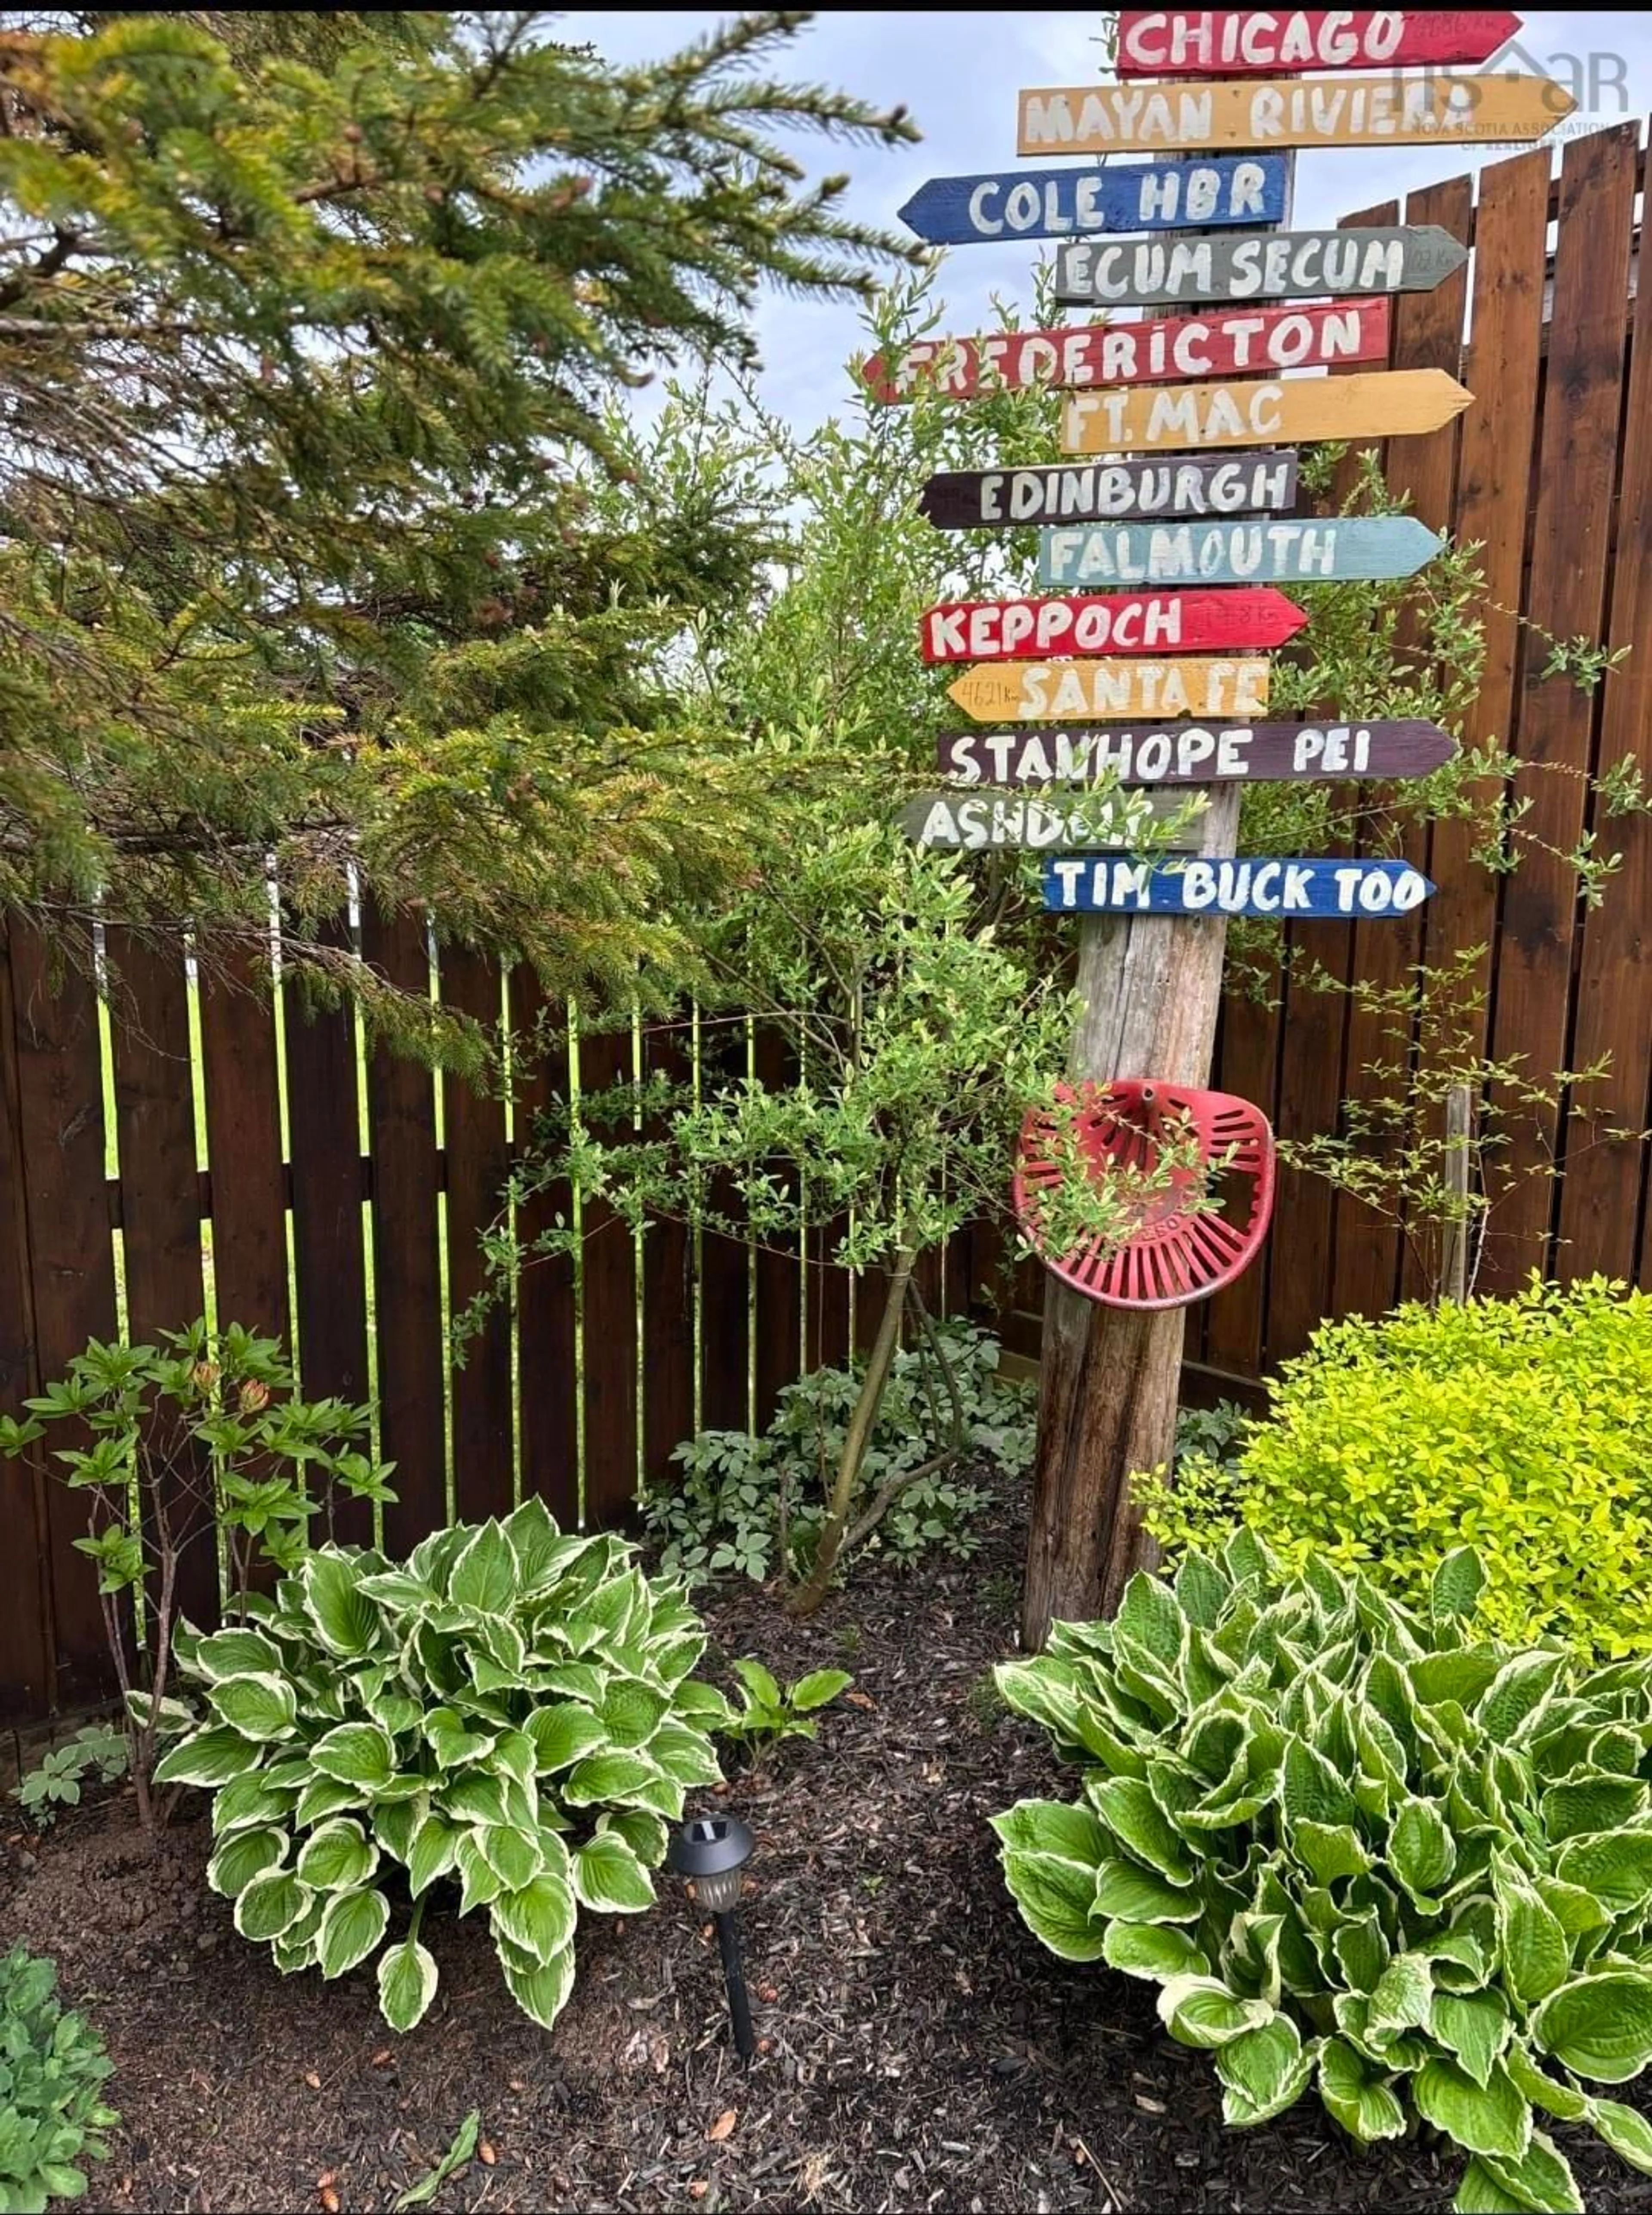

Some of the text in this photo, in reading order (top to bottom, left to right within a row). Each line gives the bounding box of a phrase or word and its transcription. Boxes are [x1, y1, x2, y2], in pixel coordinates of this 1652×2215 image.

[1125, 11, 1405, 65] CHICAGO
[1025, 89, 1212, 142] MAYAN
[969, 163, 1266, 235] COLE HBR
[1064, 243, 1212, 298] ECUM
[1229, 238, 1404, 297] SECUM
[895, 310, 1362, 394] FREDERICTON
[1146, 386, 1283, 443] MAC
[980, 463, 1289, 520] EDINBURGH
[1050, 526, 1337, 580] FALMOUTH
[930, 598, 1181, 657] KEPPOCH
[1017, 662, 1268, 720] SANTA FE
[950, 727, 1370, 787] STANHOPE PEI
[1054, 861, 1425, 912] TIM BUCK TOO
